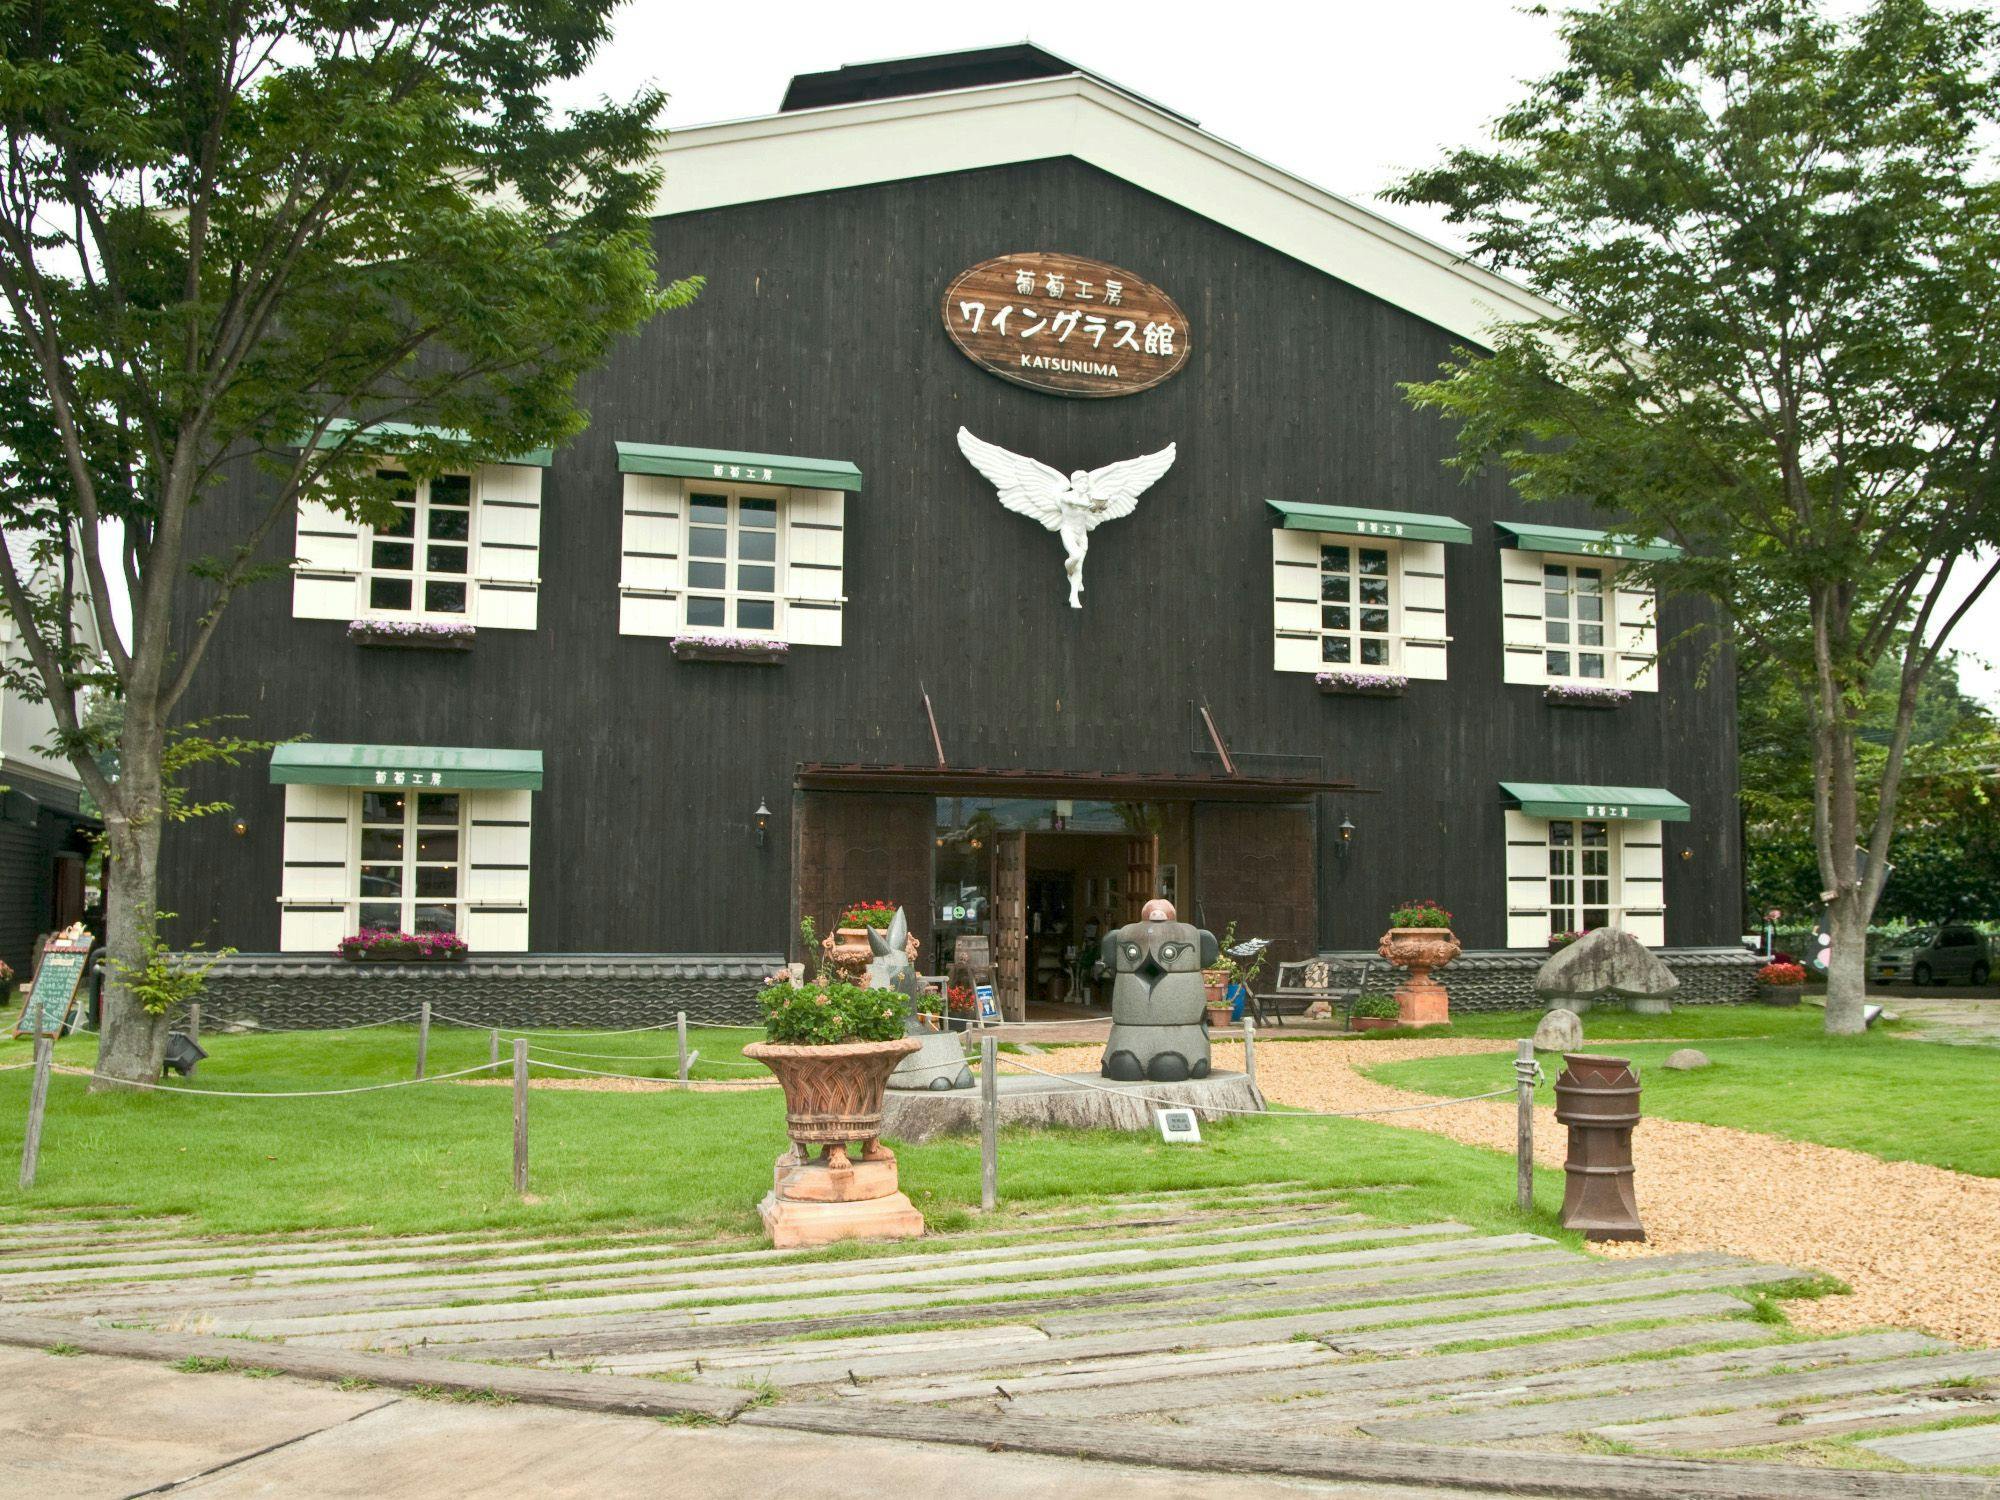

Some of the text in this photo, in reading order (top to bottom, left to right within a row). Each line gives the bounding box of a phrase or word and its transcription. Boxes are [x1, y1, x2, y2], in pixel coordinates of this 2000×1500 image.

[1015, 268, 1123, 306] 葡萄工房
[959, 301, 1175, 356] ワイングラス館
[1021, 354, 1119, 377] KATSUNUMA
